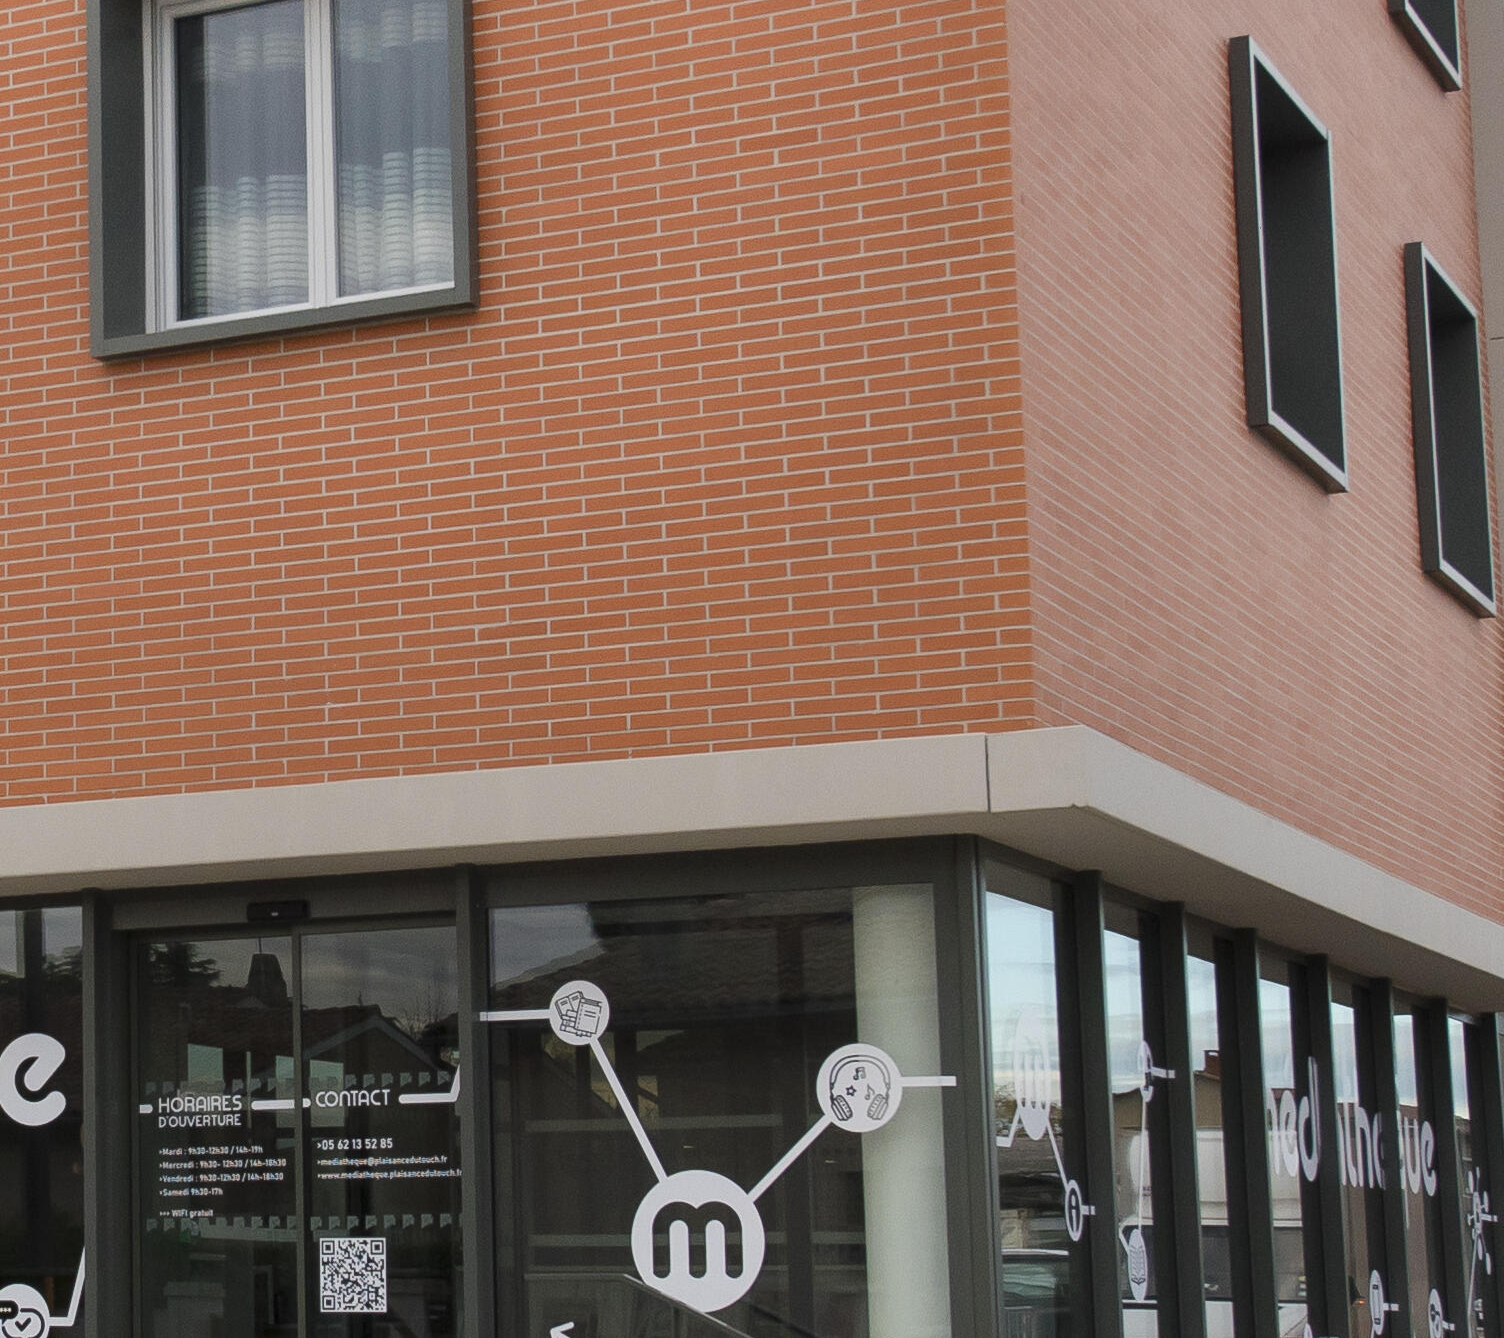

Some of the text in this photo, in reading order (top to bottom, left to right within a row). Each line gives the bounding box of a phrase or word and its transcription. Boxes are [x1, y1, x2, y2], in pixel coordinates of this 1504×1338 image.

[158, 1095, 242, 1113] HORAIRES
[316, 1089, 390, 1108] CONTACT
[158, 1114, 242, 1128] D'OUVERTURE
[337, 1139, 349, 1150] 62
[352, 1139, 362, 1149] 13
[365, 1138, 378, 1149] 52
[380, 1138, 393, 1149] 85
